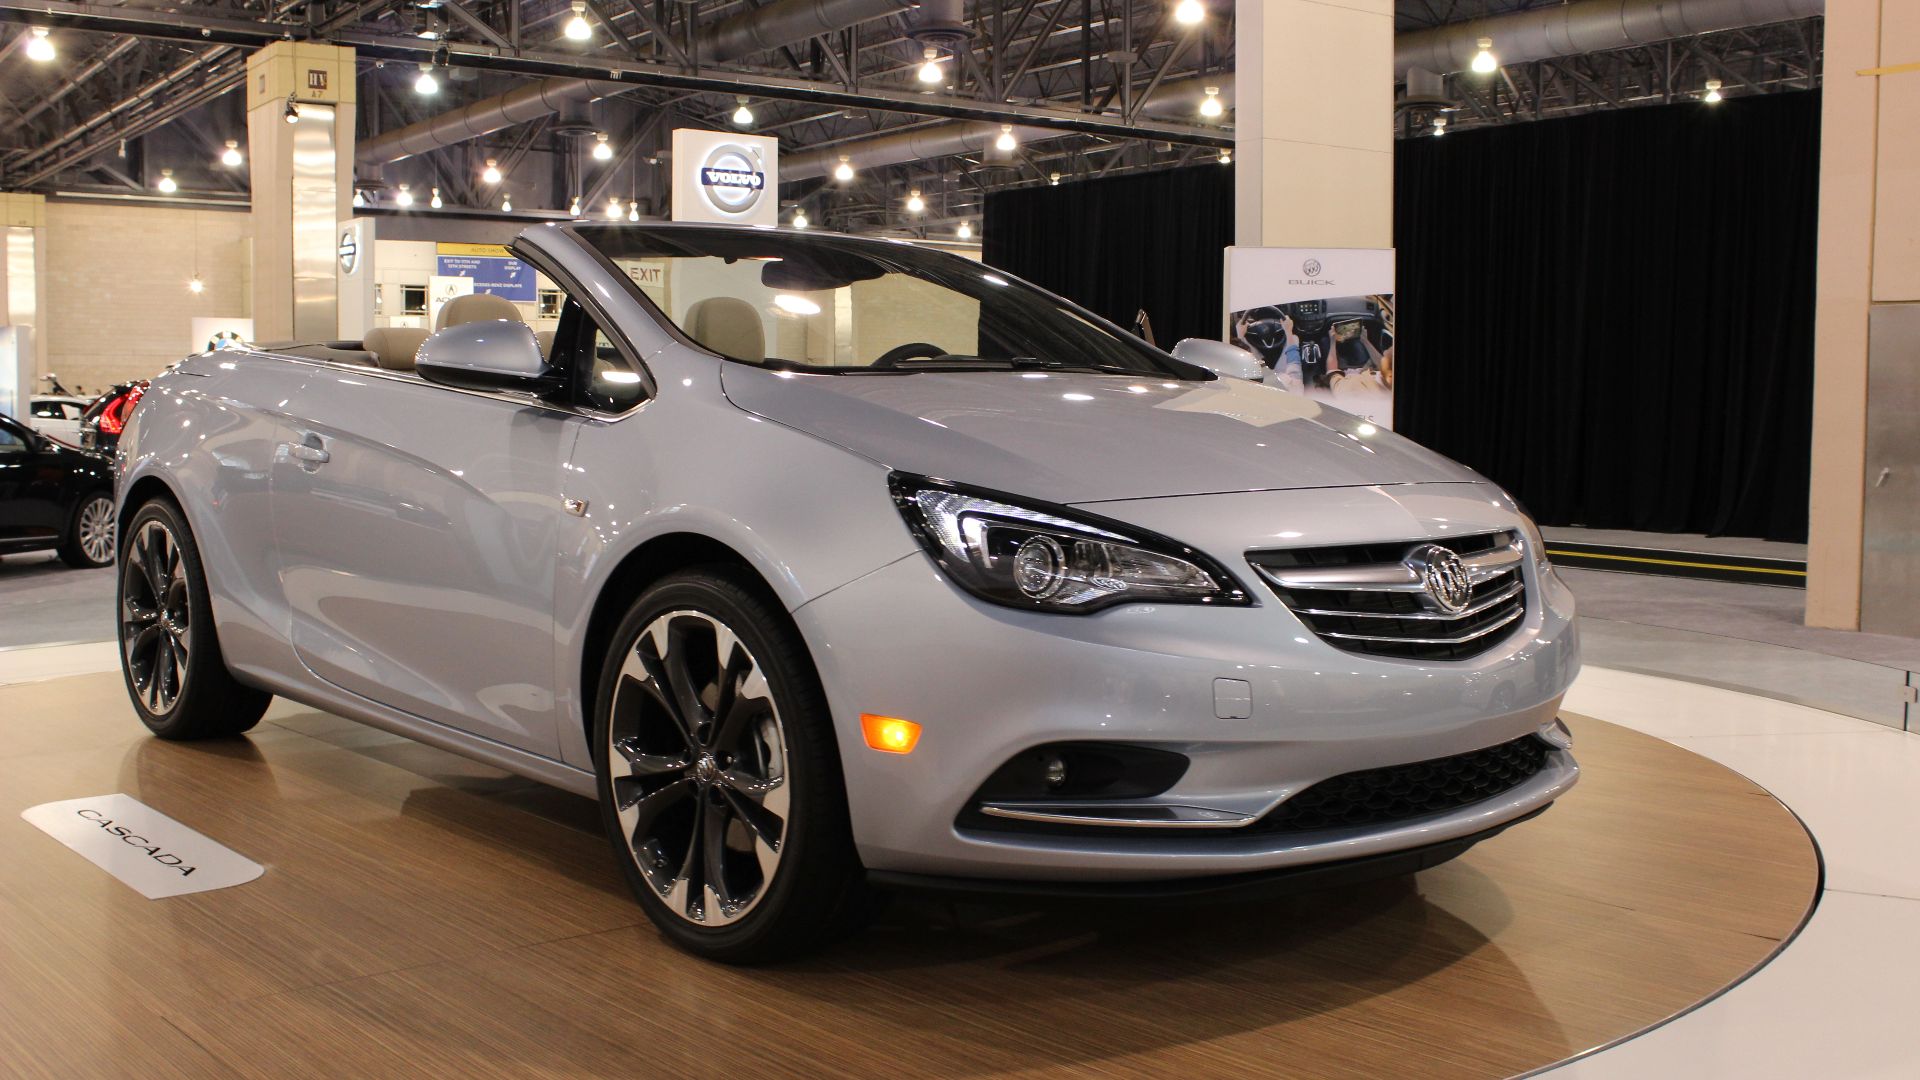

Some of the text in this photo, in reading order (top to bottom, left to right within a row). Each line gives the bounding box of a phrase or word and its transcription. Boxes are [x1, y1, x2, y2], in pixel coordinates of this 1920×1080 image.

[705, 171, 762, 187] VOLVO
[630, 267, 661, 282] EXIT
[77, 809, 196, 877] CASCADA
